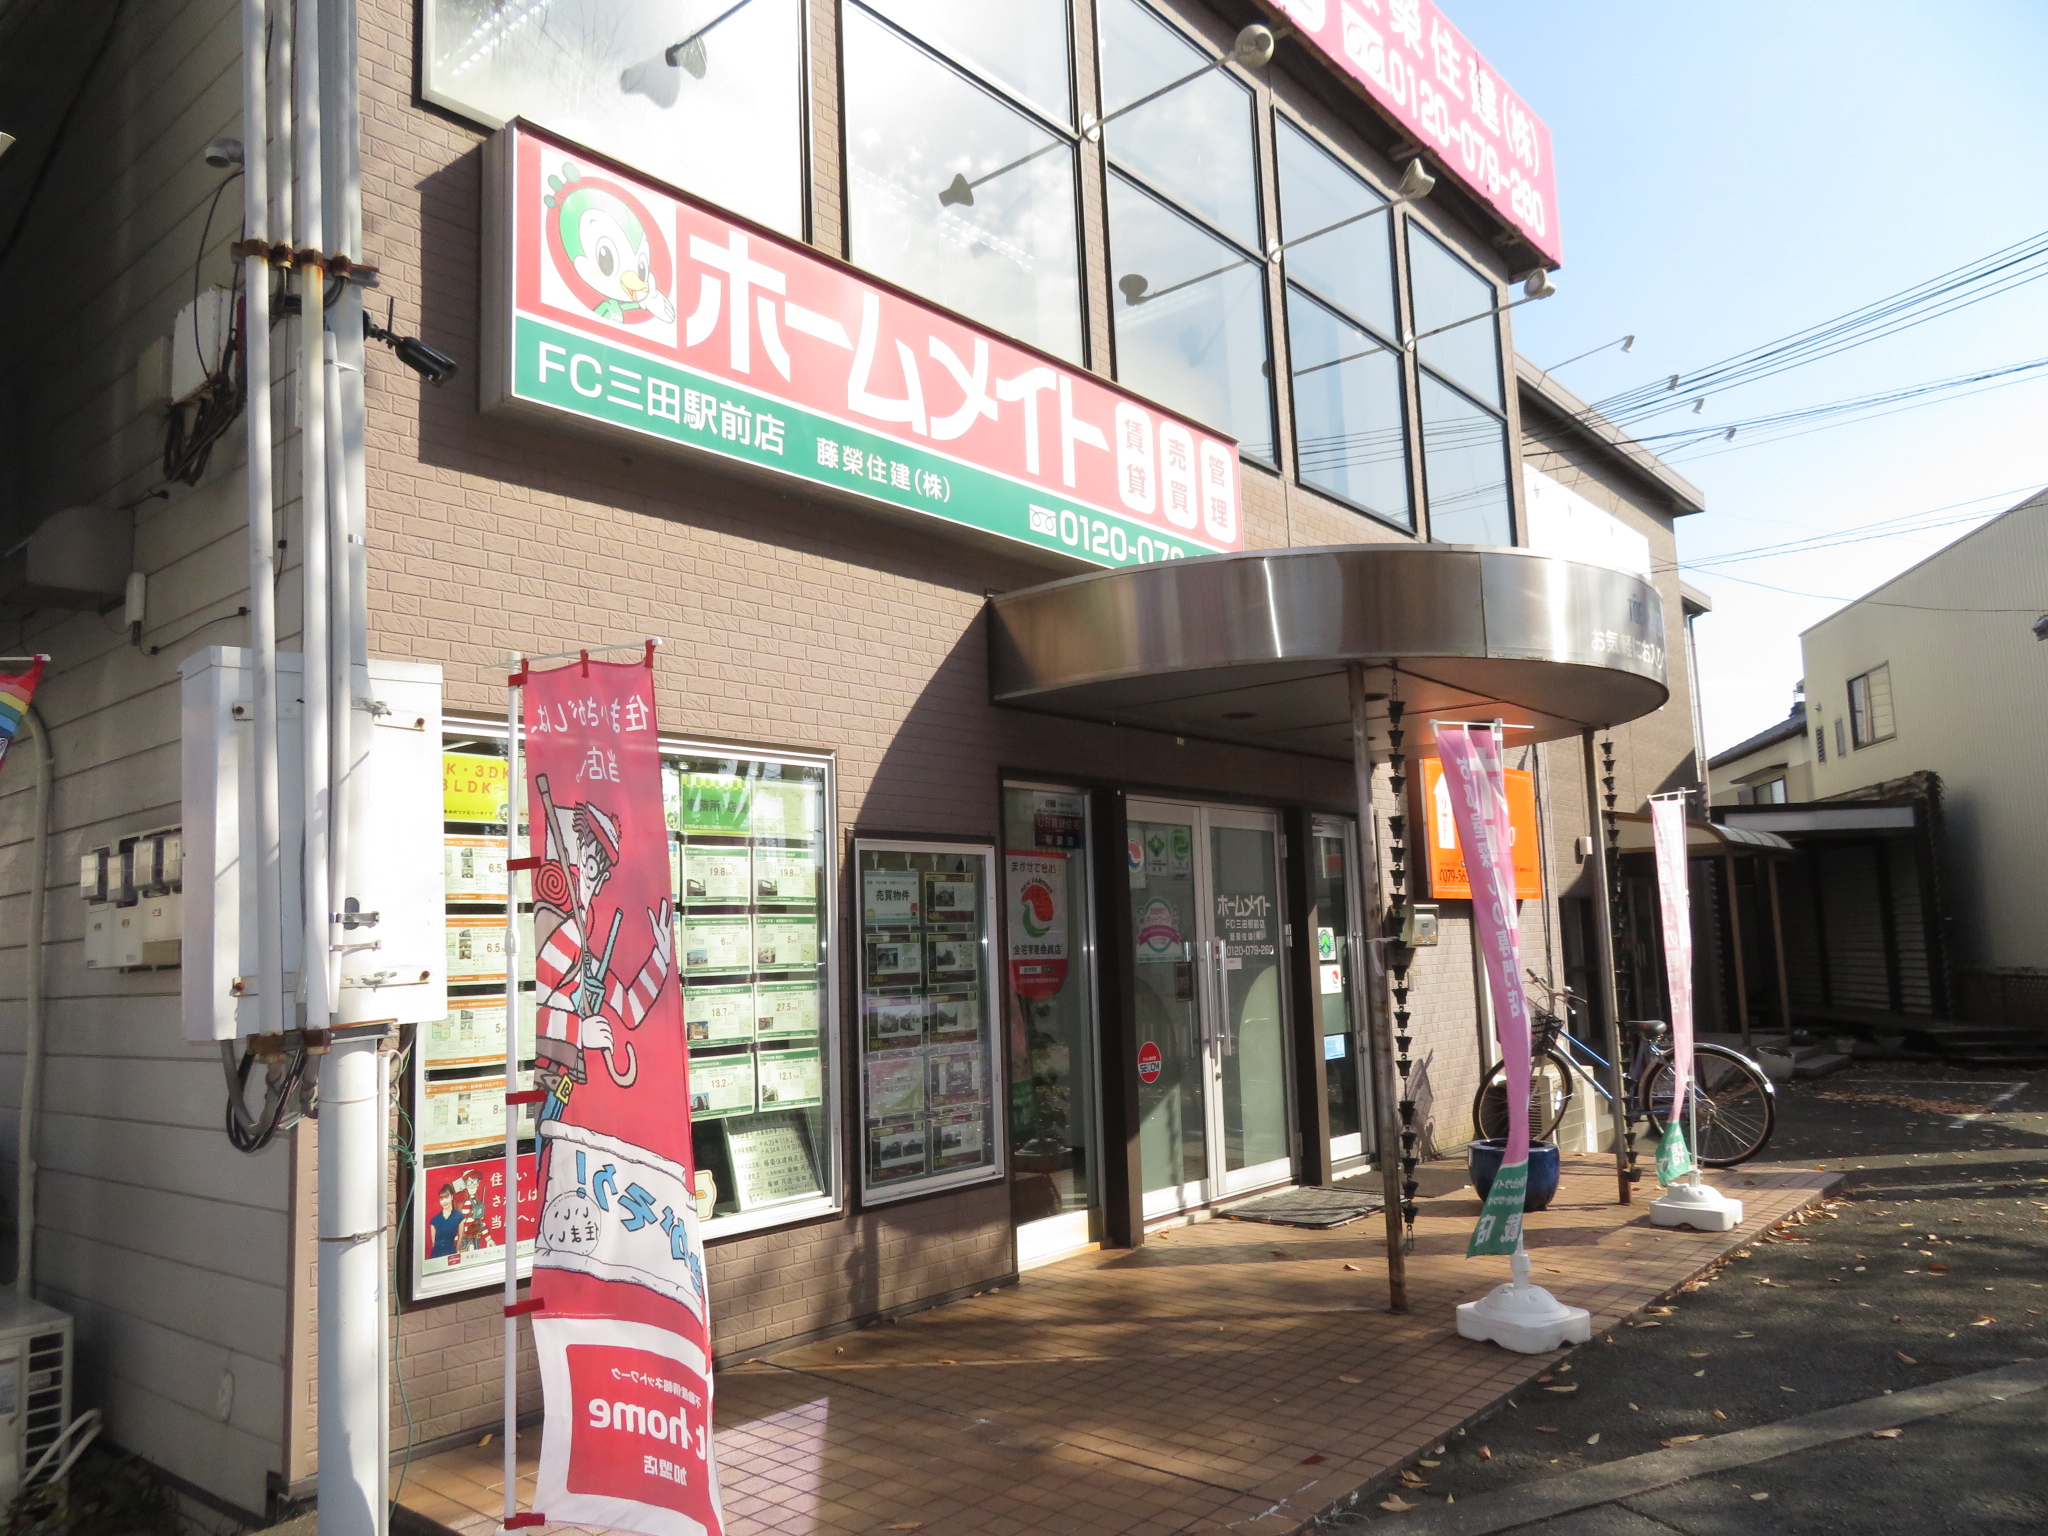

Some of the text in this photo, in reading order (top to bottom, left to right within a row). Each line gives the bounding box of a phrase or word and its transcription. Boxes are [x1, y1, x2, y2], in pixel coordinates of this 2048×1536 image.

[686, 229, 1110, 490] ホームメイト
[536, 340, 786, 457] FC三田駅前店
[815, 436, 952, 504] 藤榮住建(株)
[1123, 412, 1150, 500] 賃貸
[1166, 436, 1191, 516] 売買
[1207, 453, 1229, 529] 管理
[875, 889, 910, 901] 売買物件
[1217, 894, 1272, 917] ホームメイト
[1140, 1062, 1160, 1073] SECOM
[491, 1214, 535, 1230] 当へ。
